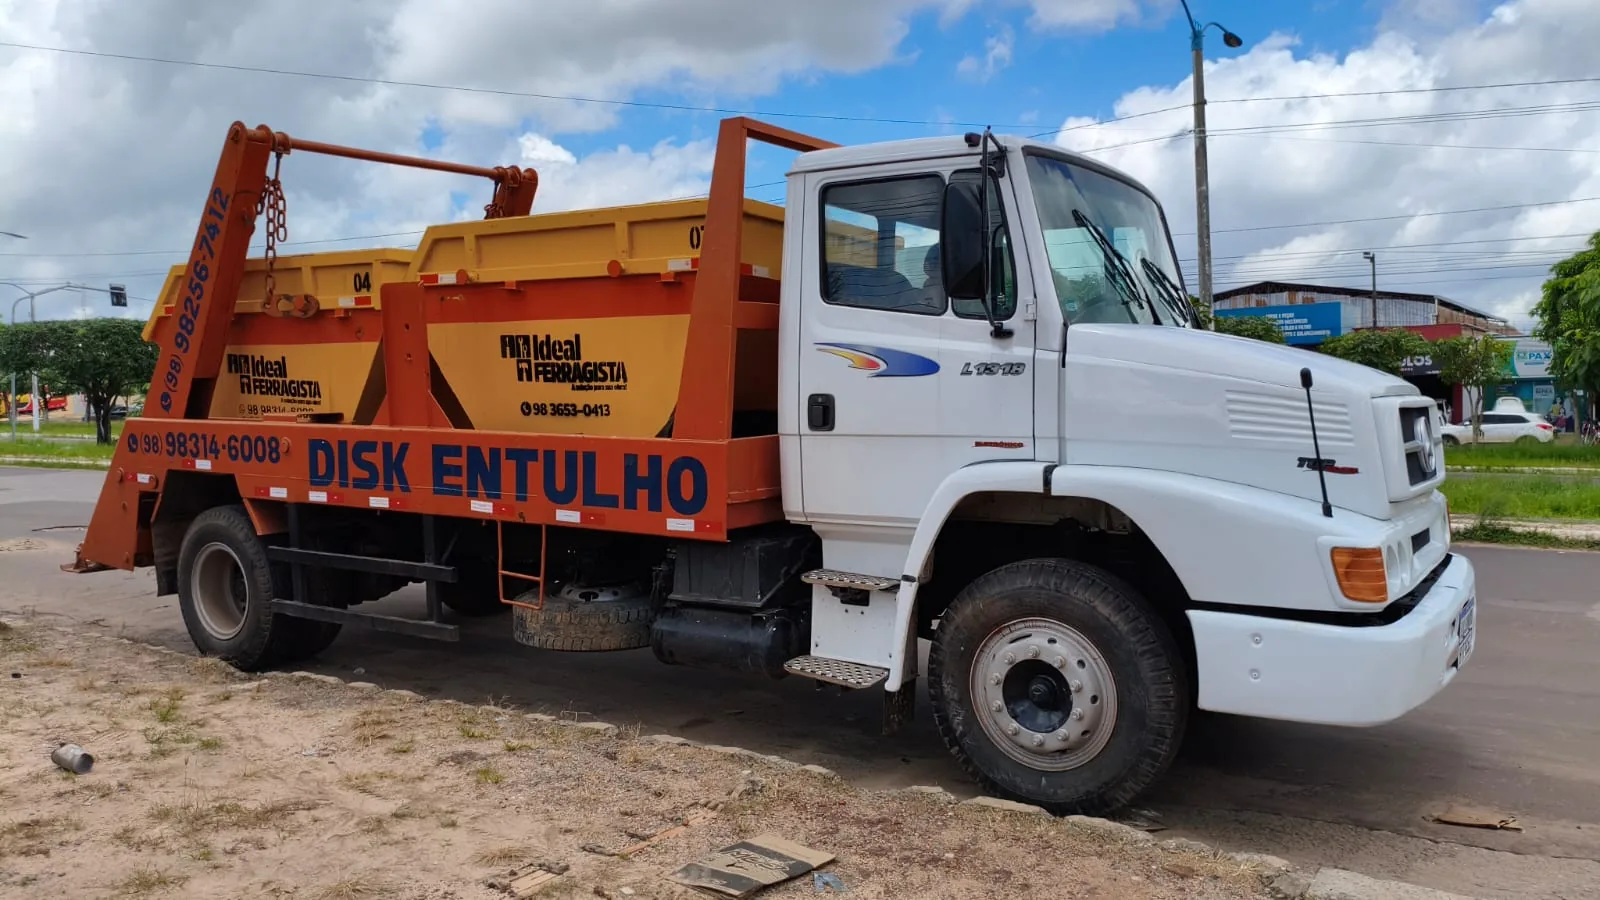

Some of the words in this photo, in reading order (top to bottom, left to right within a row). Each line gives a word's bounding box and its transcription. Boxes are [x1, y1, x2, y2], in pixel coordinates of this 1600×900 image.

[689, 225, 704, 250] 0
[354, 271, 371, 292] 04
[532, 333, 582, 361] Ideal
[164, 354, 184, 393] (98)
[251, 355, 288, 378] Ideal
[534, 361, 628, 383] FERRAGISTA
[252, 378, 322, 399] FERRAGISTA
[533, 402, 548, 416] 98
[140, 432, 163, 456] (98)
[308, 438, 411, 493] DISK
[431, 443, 708, 516] ENTULHO
